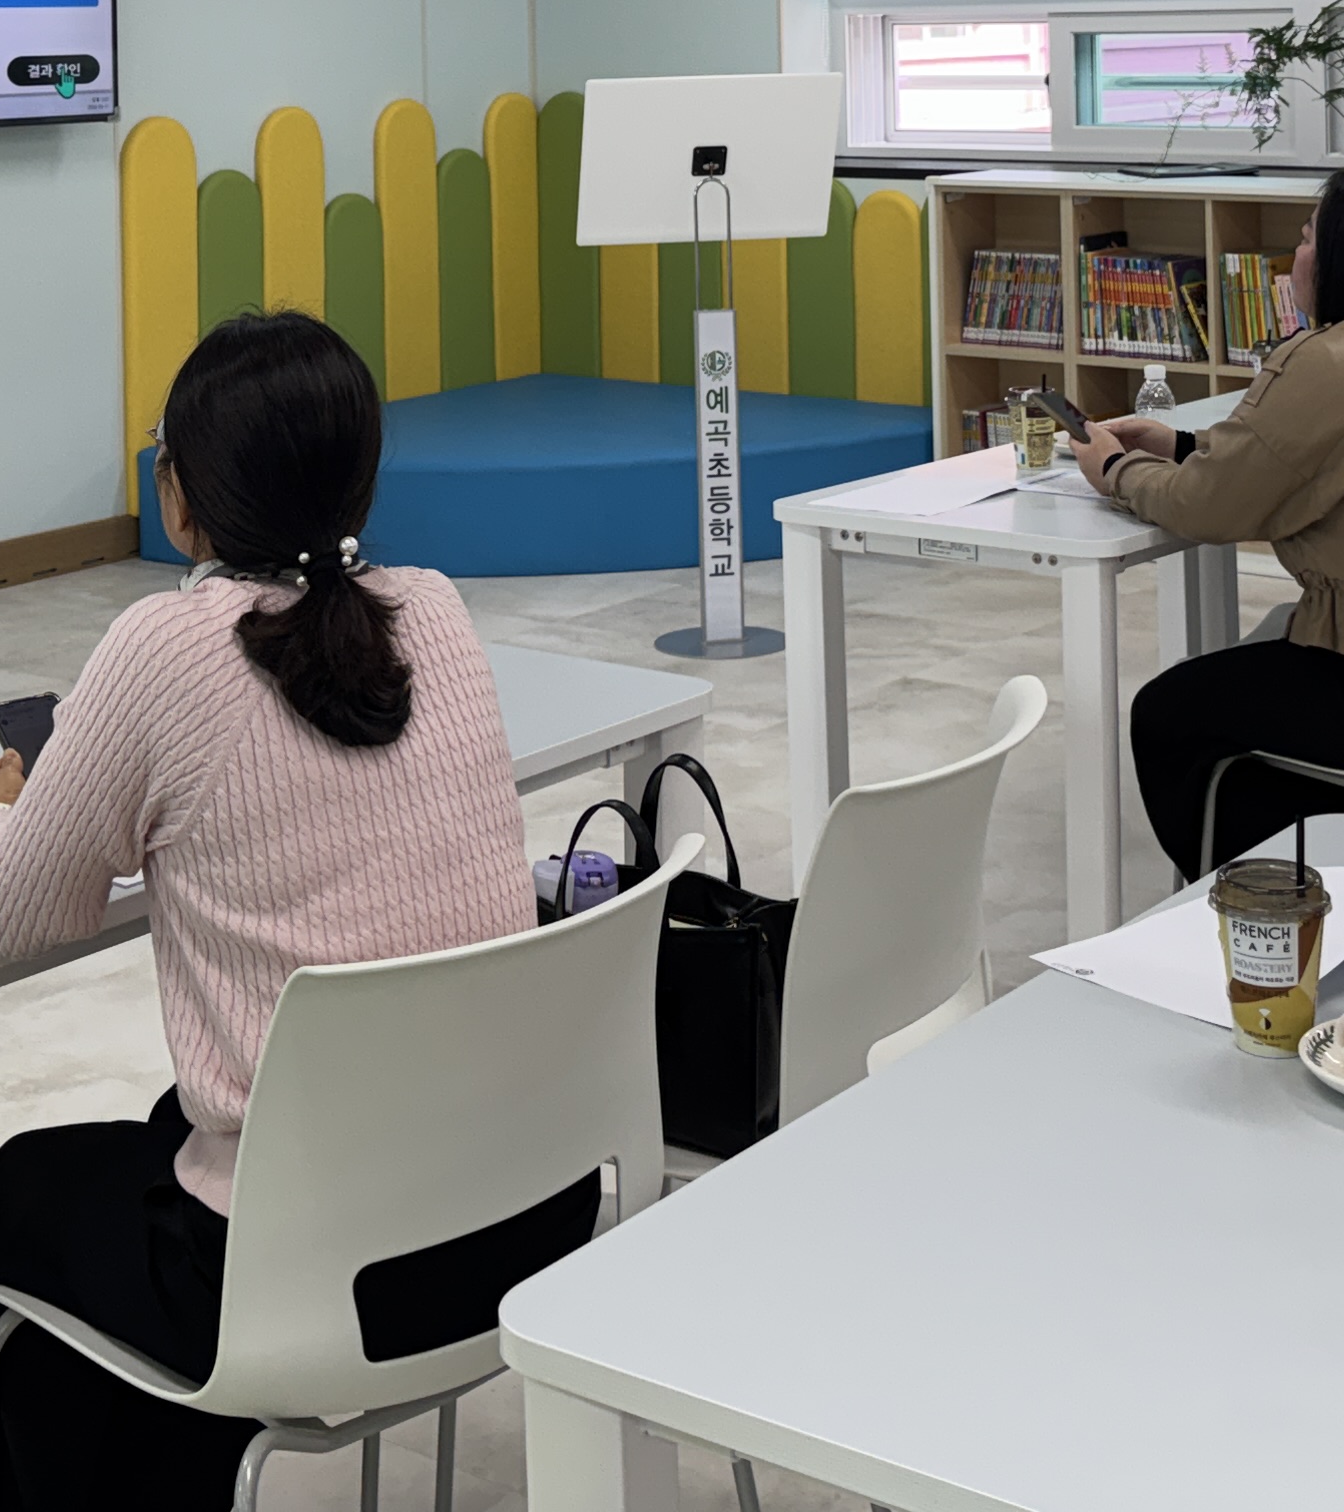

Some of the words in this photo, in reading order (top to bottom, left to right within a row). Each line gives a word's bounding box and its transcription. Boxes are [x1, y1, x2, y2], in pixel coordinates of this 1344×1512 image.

[27, 63, 53, 79] 결과
[705, 385, 735, 578] 예곡초등학교
[1232, 920, 1291, 940] FRENCH
[1233, 938, 1291, 953] CAFÉ
